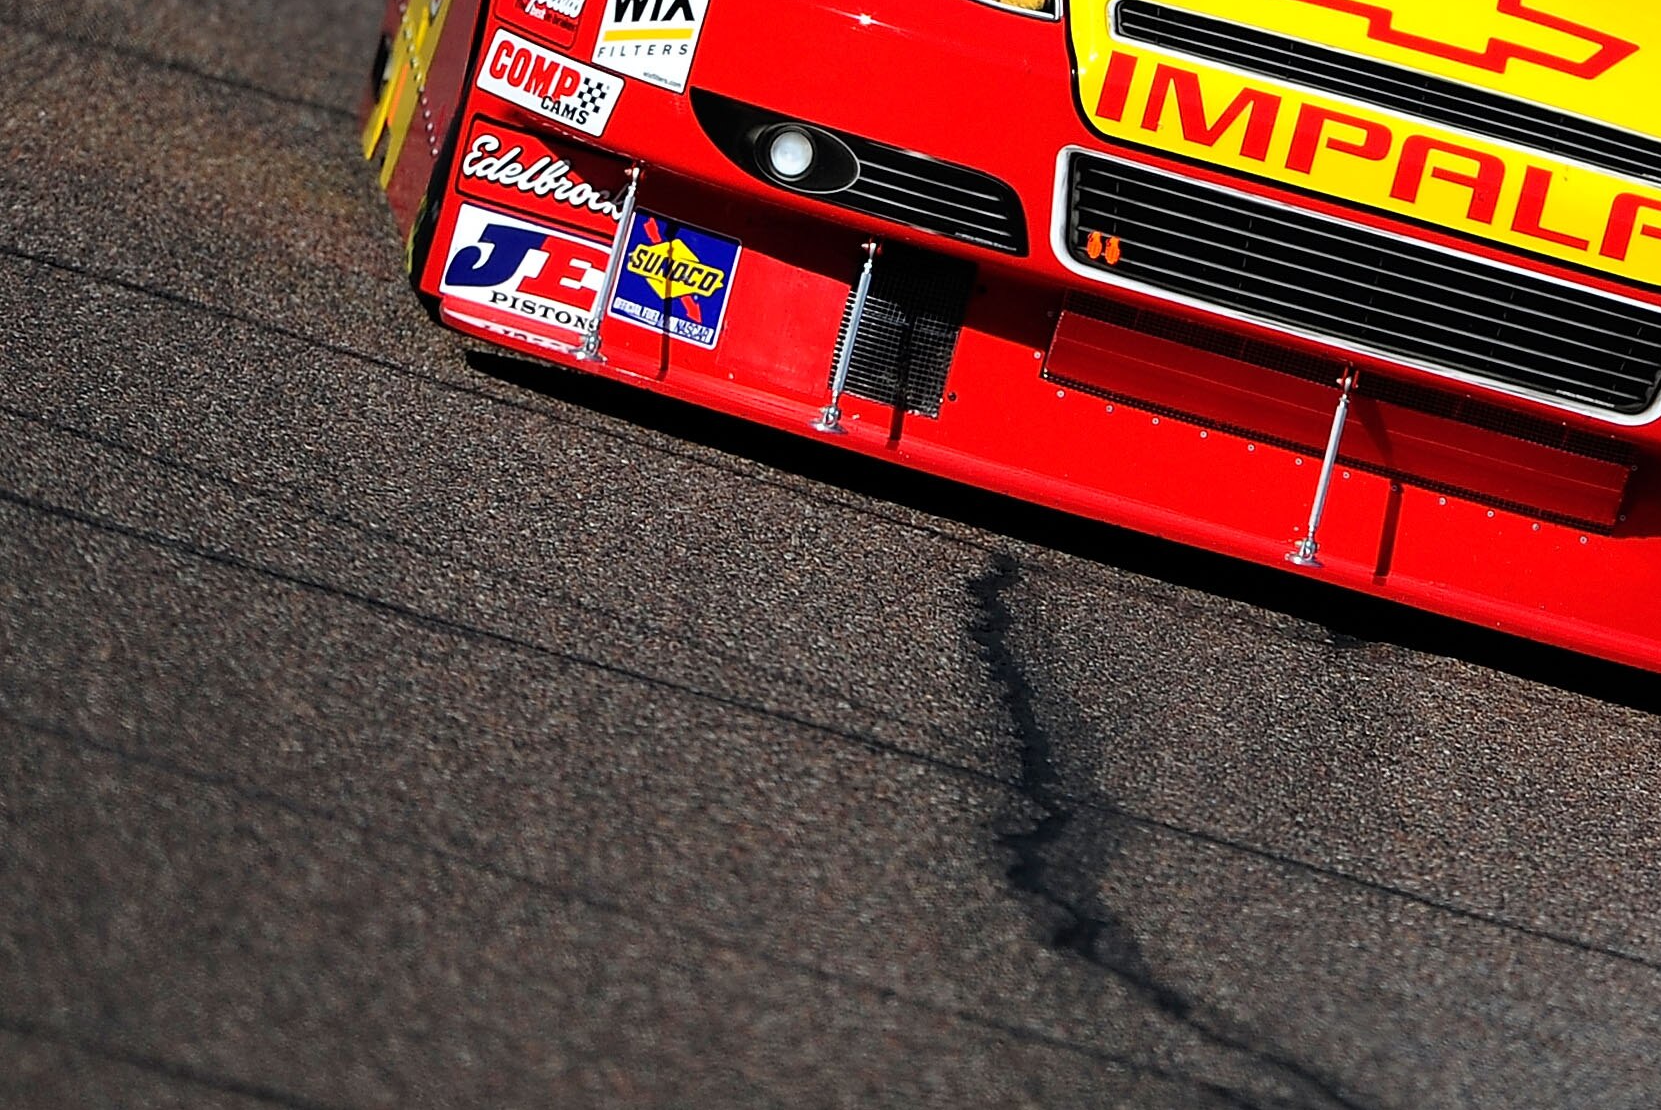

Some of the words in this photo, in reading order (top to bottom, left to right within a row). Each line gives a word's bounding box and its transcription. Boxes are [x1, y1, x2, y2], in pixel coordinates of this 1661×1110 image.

[489, 39, 581, 102] COMP
[597, 43, 689, 58] FILTERS
[540, 95, 590, 126] CAMS
[445, 223, 611, 312] JE
[631, 248, 720, 292] SUNOCO
